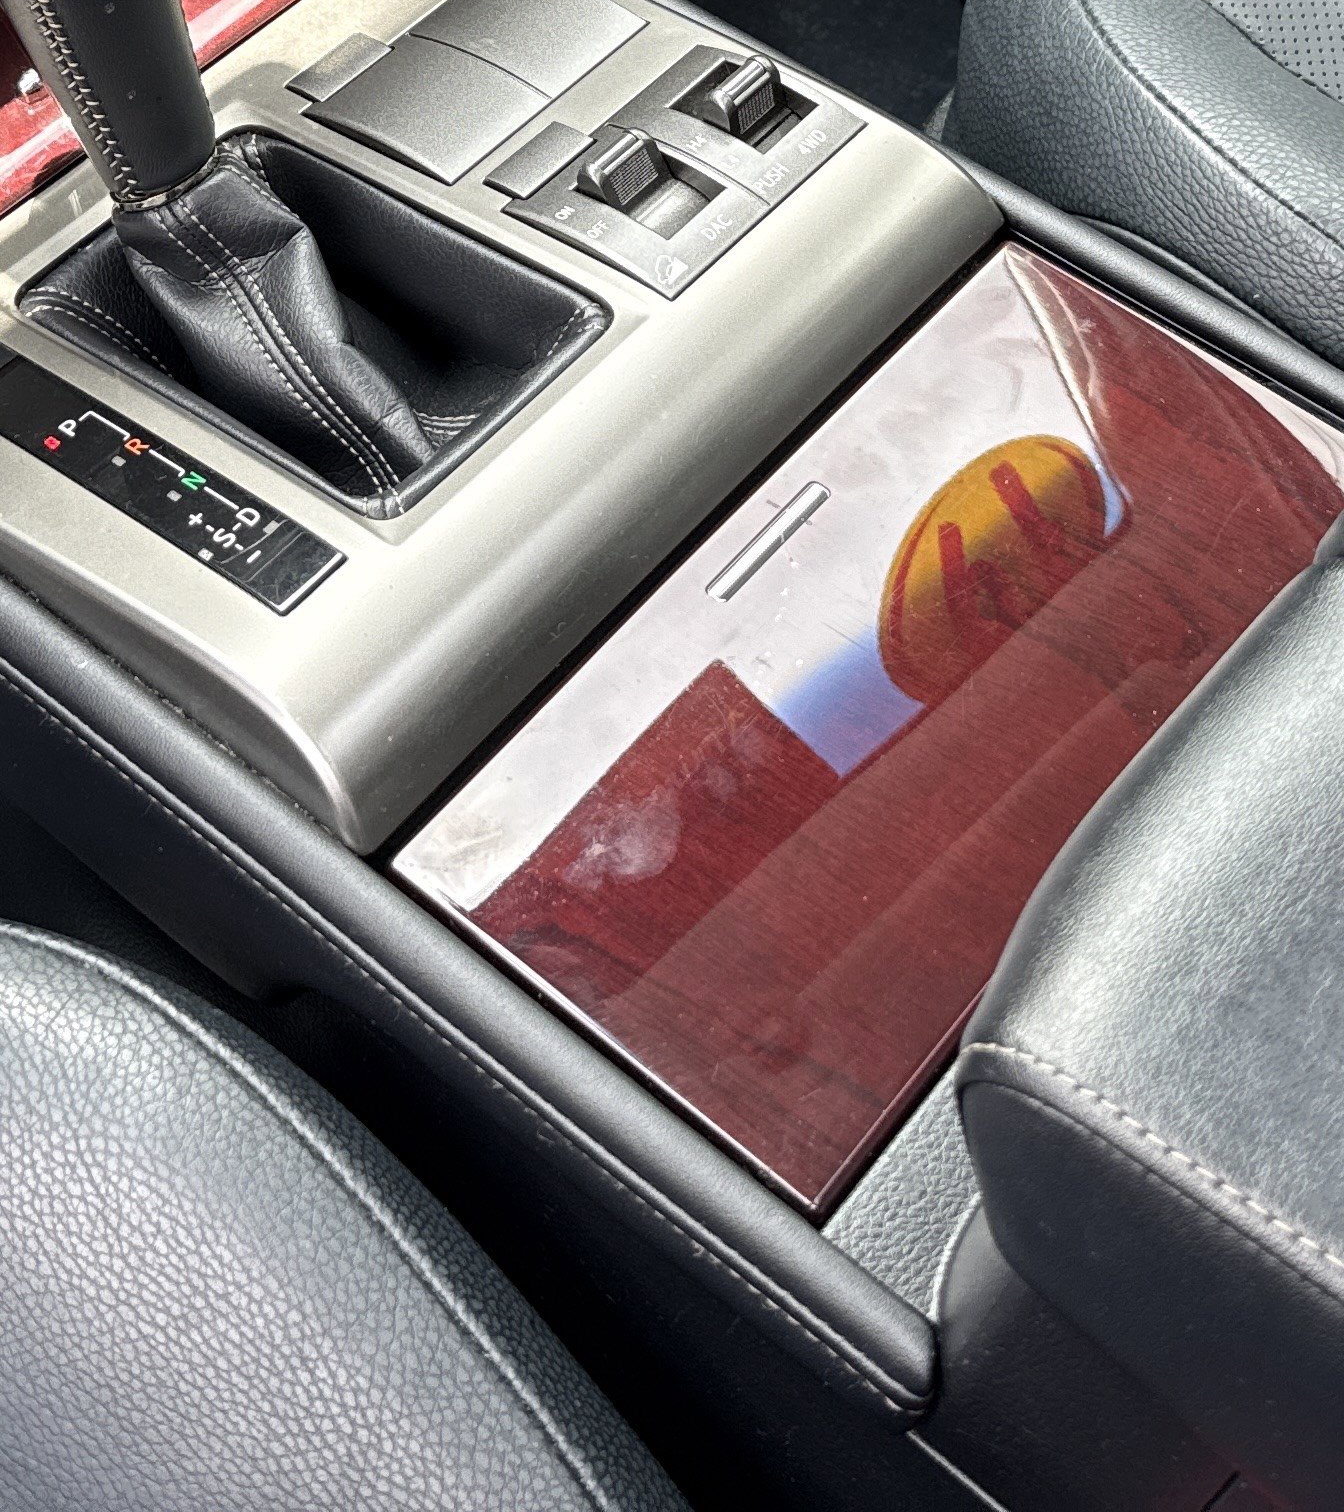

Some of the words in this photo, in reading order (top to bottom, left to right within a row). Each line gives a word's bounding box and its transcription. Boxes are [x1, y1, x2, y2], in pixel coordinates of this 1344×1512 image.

[754, 162, 791, 198] PUSH
[797, 128, 827, 156] 4WD
[555, 205, 576, 222] ON
[586, 220, 610, 240] OFF
[700, 213, 734, 241] DAC
[58, 418, 78, 438] P
[123, 438, 150, 456] R
[181, 471, 206, 490] N
[235, 507, 261, 527] D
